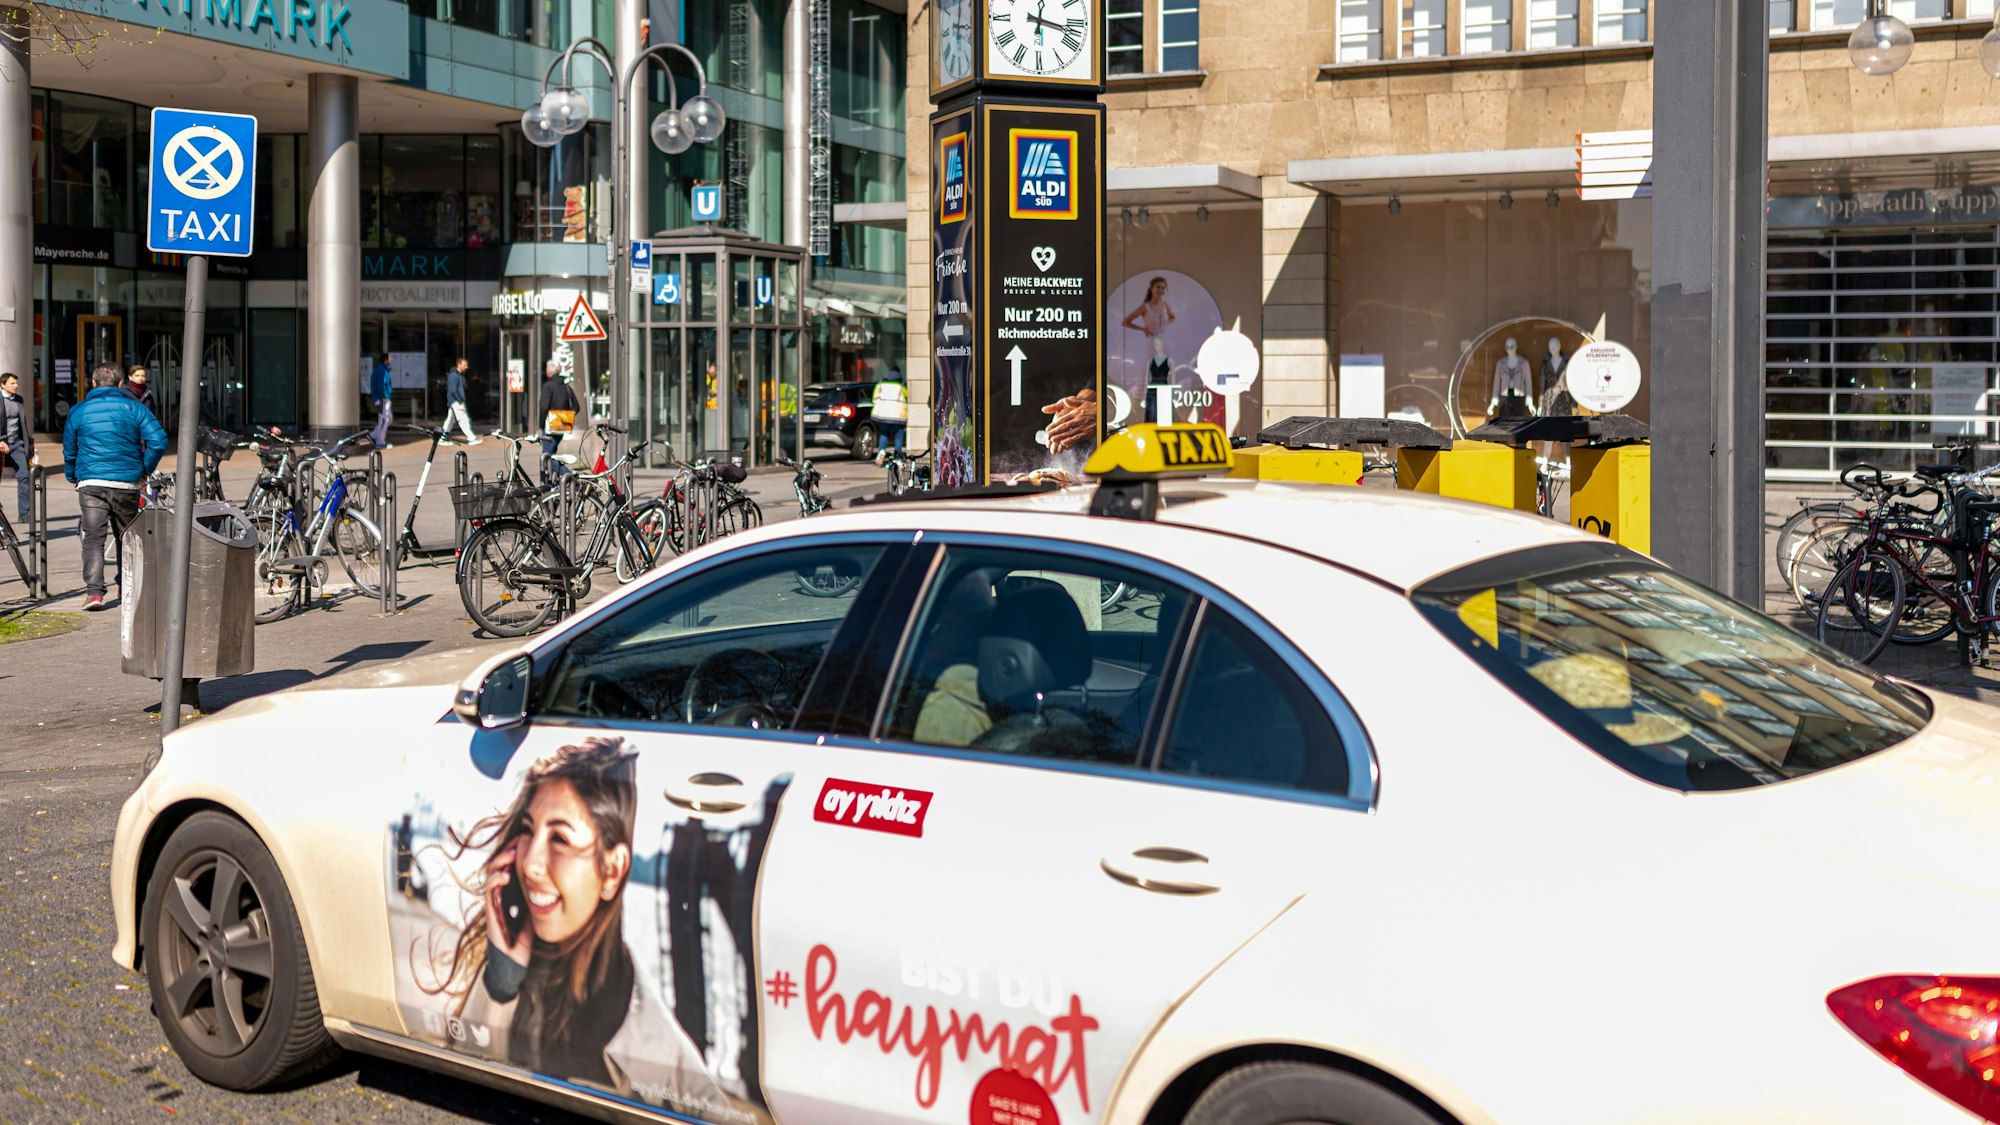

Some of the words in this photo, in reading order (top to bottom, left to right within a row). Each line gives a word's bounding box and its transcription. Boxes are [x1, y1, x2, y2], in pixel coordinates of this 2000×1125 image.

[945, 182, 964, 202] ALDI
[1021, 179, 1066, 197] ALDI
[697, 191, 716, 216] U
[1035, 195, 1053, 207] SÜD
[160, 208, 240, 243] TAXI
[34, 246, 109, 261] Mayersche.de
[935, 252, 968, 282] Frische
[757, 277, 772, 304] U
[1003, 277, 1033, 287] MEINE
[1033, 277, 1083, 288] BACKWELT
[937, 301, 948, 315] Nur
[948, 300, 960, 314] 200
[960, 301, 967, 314] m
[1004, 307, 1033, 323] Nur
[1035, 307, 1064, 323] 200
[1067, 310, 1082, 323] m
[997, 327, 1076, 340] Richmodstraße
[1076, 328, 1089, 339] 31
[1174, 390, 1213, 408] 2020
[1157, 430, 1226, 465] TAXI
[997, 959, 1064, 1017] DU
